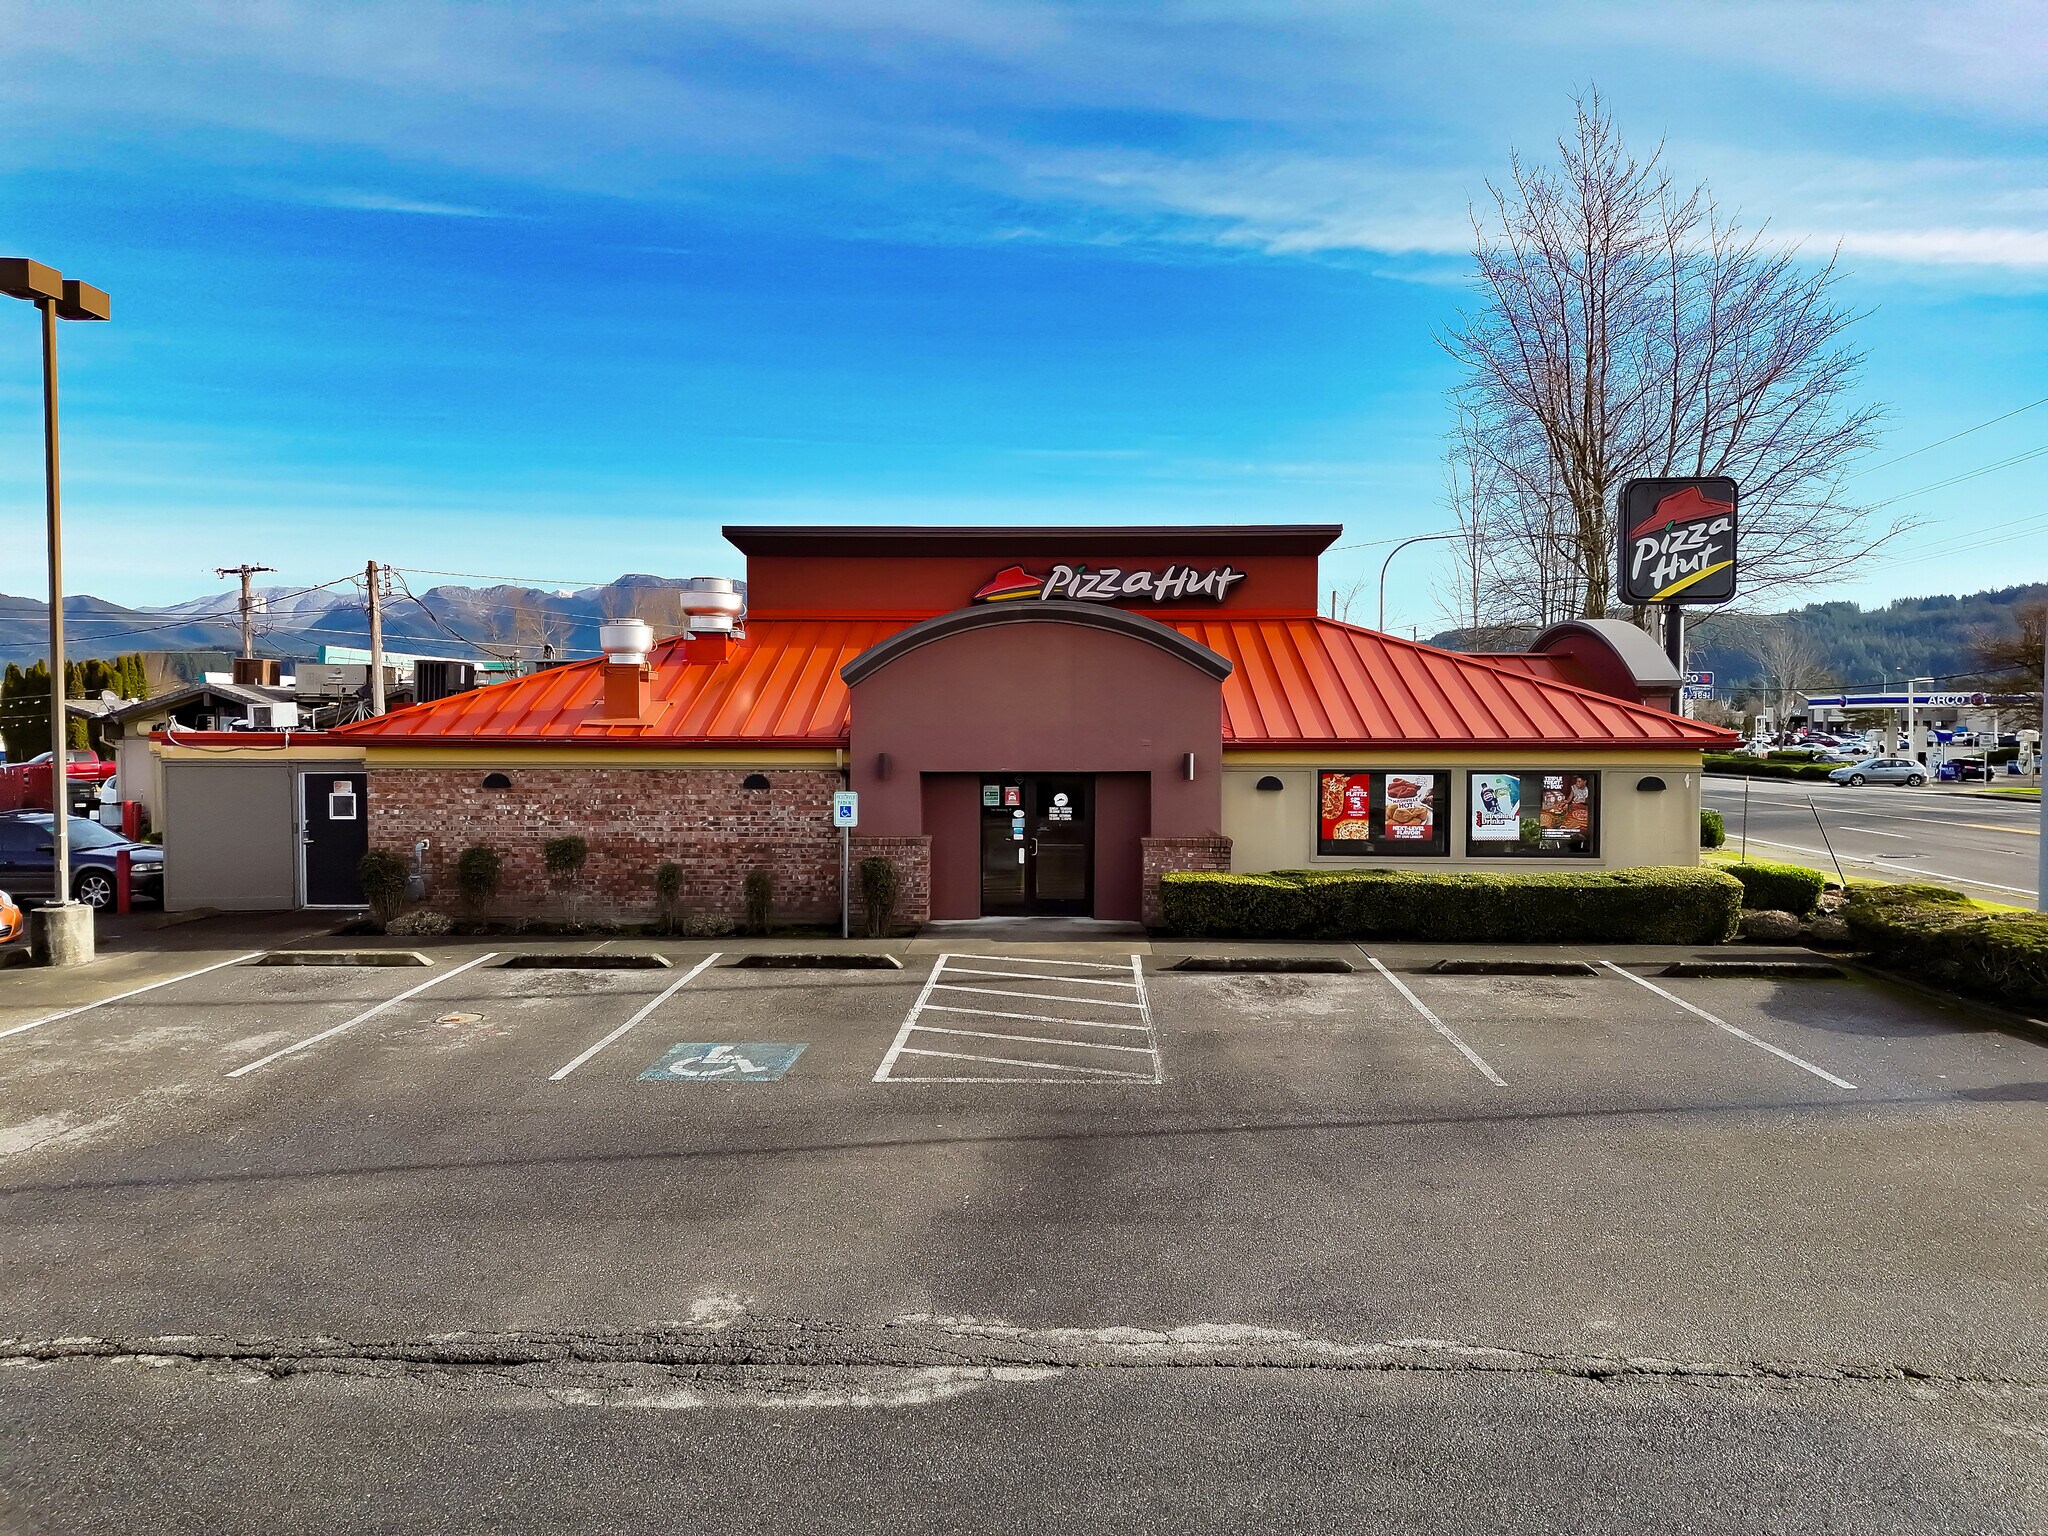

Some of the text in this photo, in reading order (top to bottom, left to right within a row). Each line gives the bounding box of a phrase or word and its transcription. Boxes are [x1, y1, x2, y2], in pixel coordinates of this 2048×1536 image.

[1632, 518, 1733, 581] Pizza
[1650, 543, 1723, 590] Hut
[1041, 564, 1245, 601] Pizza Hut
[1927, 695, 1965, 705] ARCO
